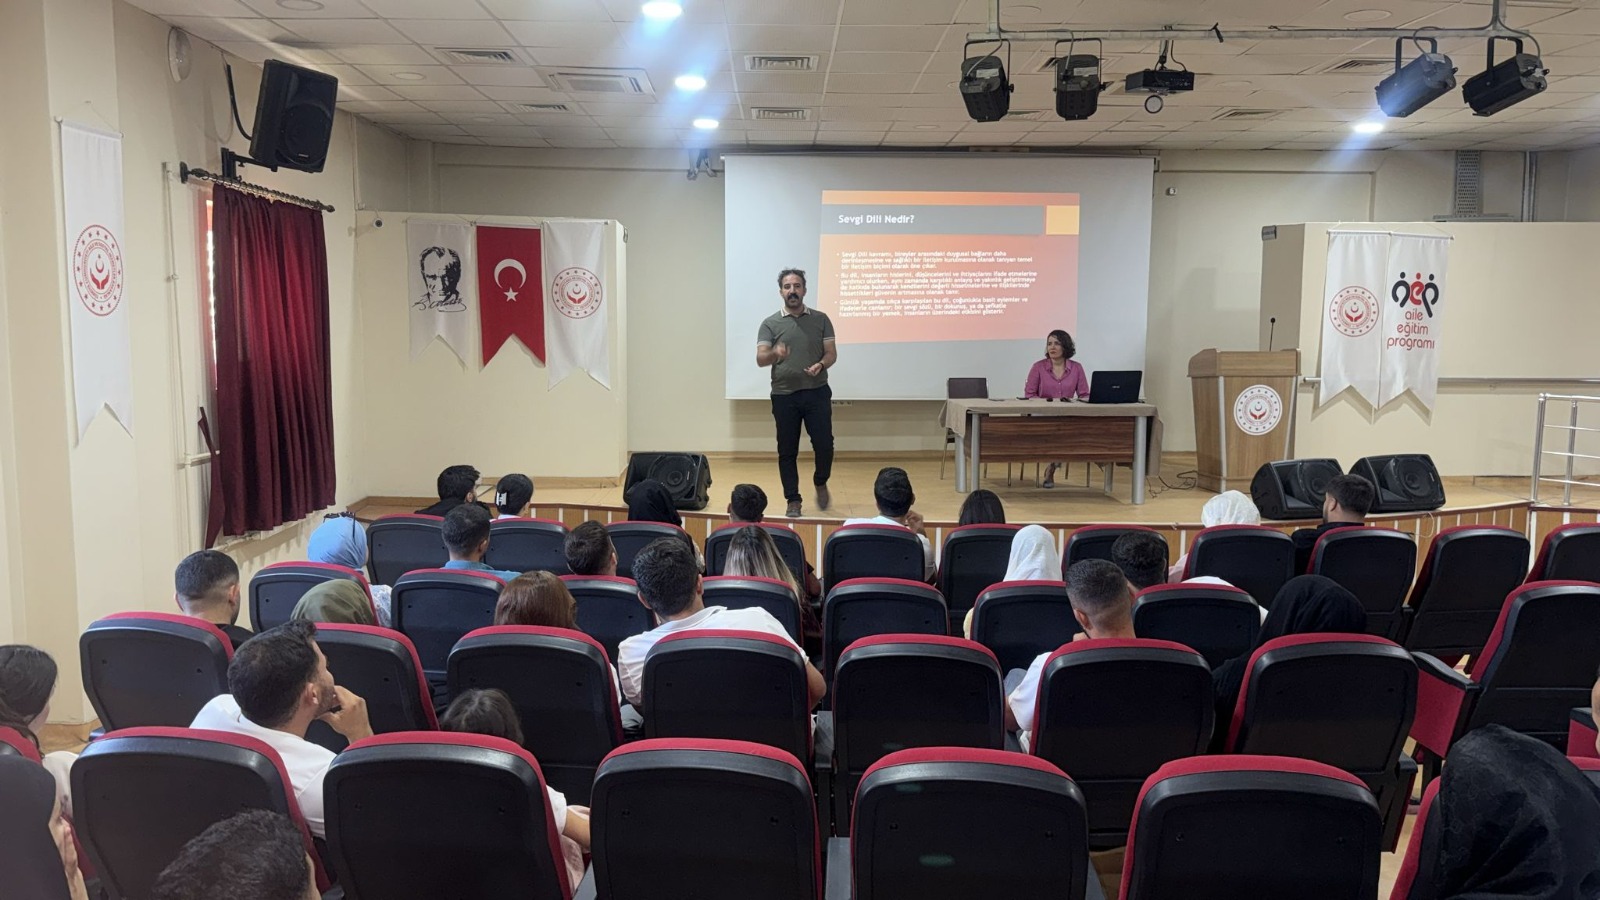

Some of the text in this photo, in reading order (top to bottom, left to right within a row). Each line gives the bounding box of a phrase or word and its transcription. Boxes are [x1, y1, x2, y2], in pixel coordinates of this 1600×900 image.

[838, 215, 914, 226] Sevgi Dili Nedir?
[1404, 308, 1424, 320] aile
[1396, 322, 1428, 337] eğitim
[1386, 337, 1434, 350] programı
